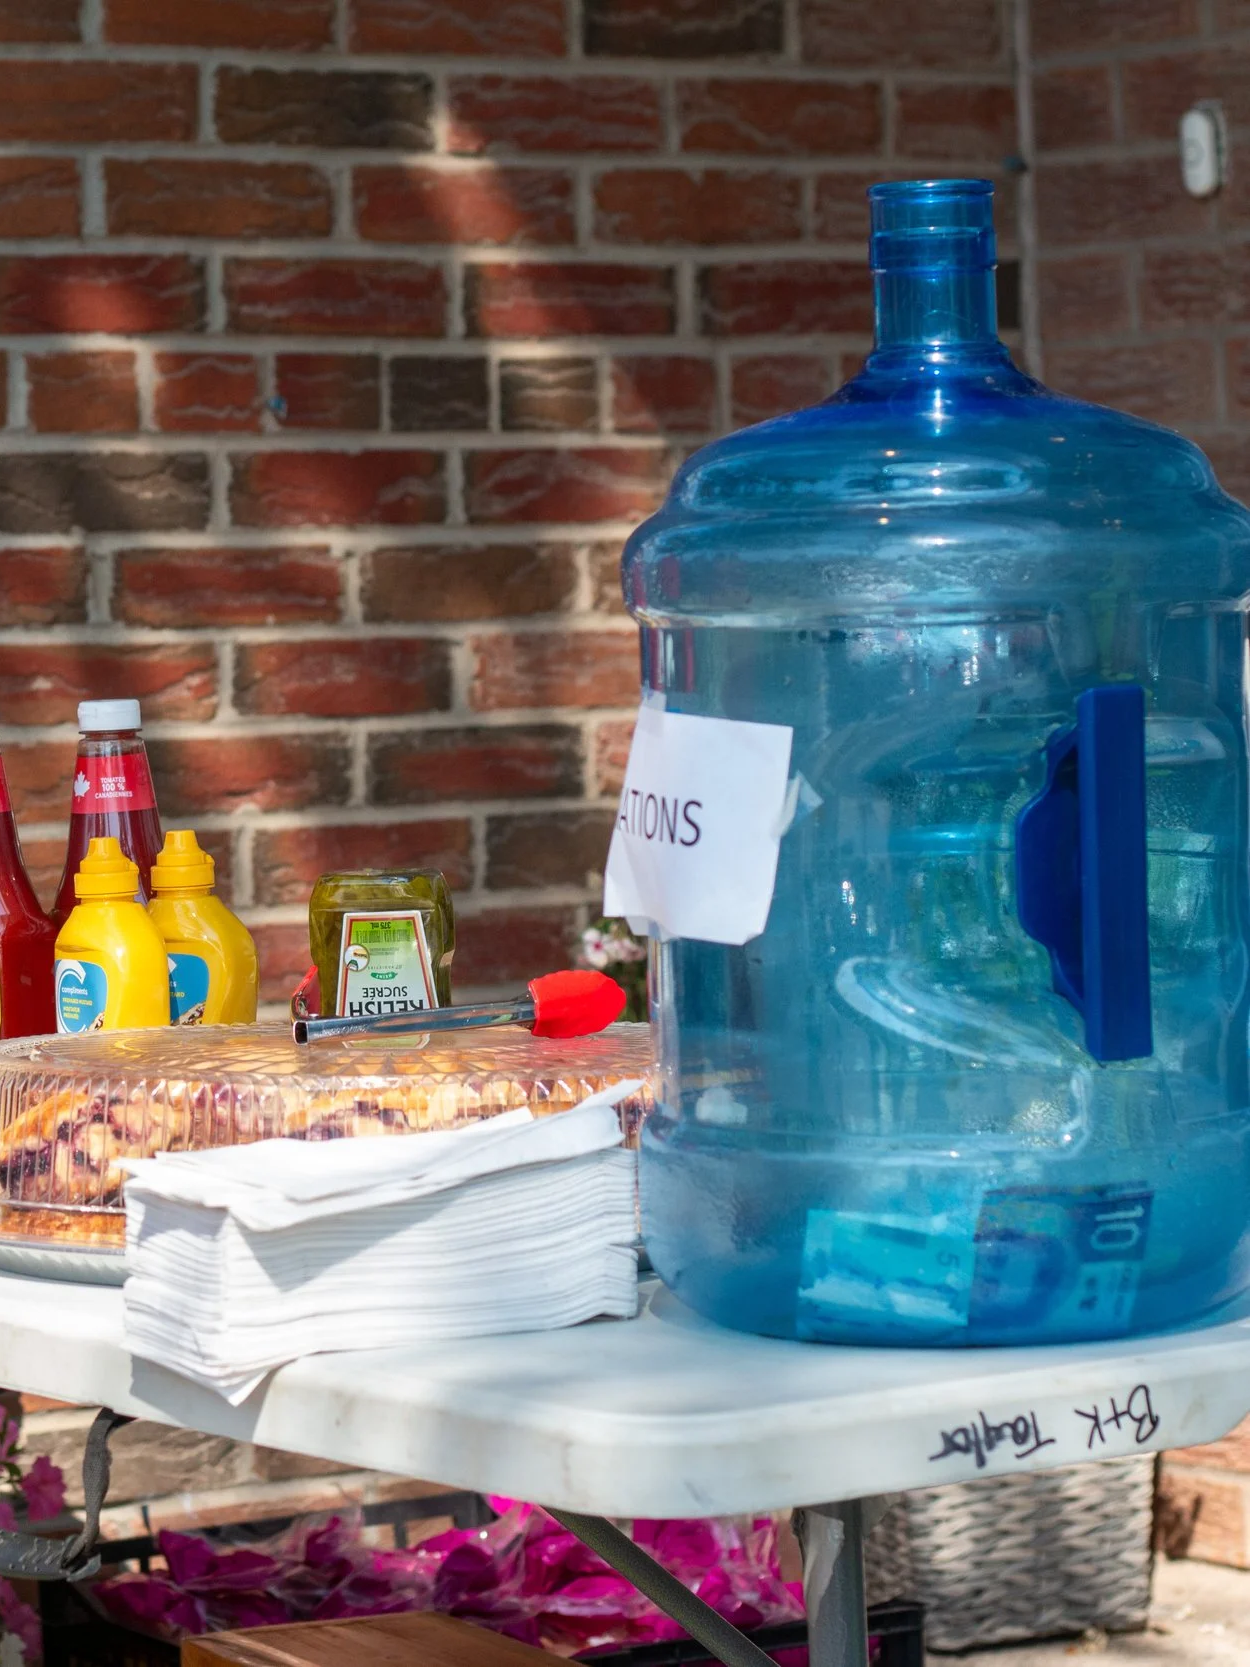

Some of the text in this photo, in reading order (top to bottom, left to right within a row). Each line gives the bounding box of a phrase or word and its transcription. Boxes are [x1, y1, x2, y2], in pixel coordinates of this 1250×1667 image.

[101, 776, 126, 784] TOMATES
[101, 784, 116, 792] 100
[95, 790, 133, 799] CANADIENNES
[617, 788, 703, 847] ATIONS
[61, 987, 88, 996] compliments
[362, 985, 408, 1001] SUCRÉE
[1090, 1205, 1145, 1251] 10
[929, 1410, 1056, 1470] Taylor
